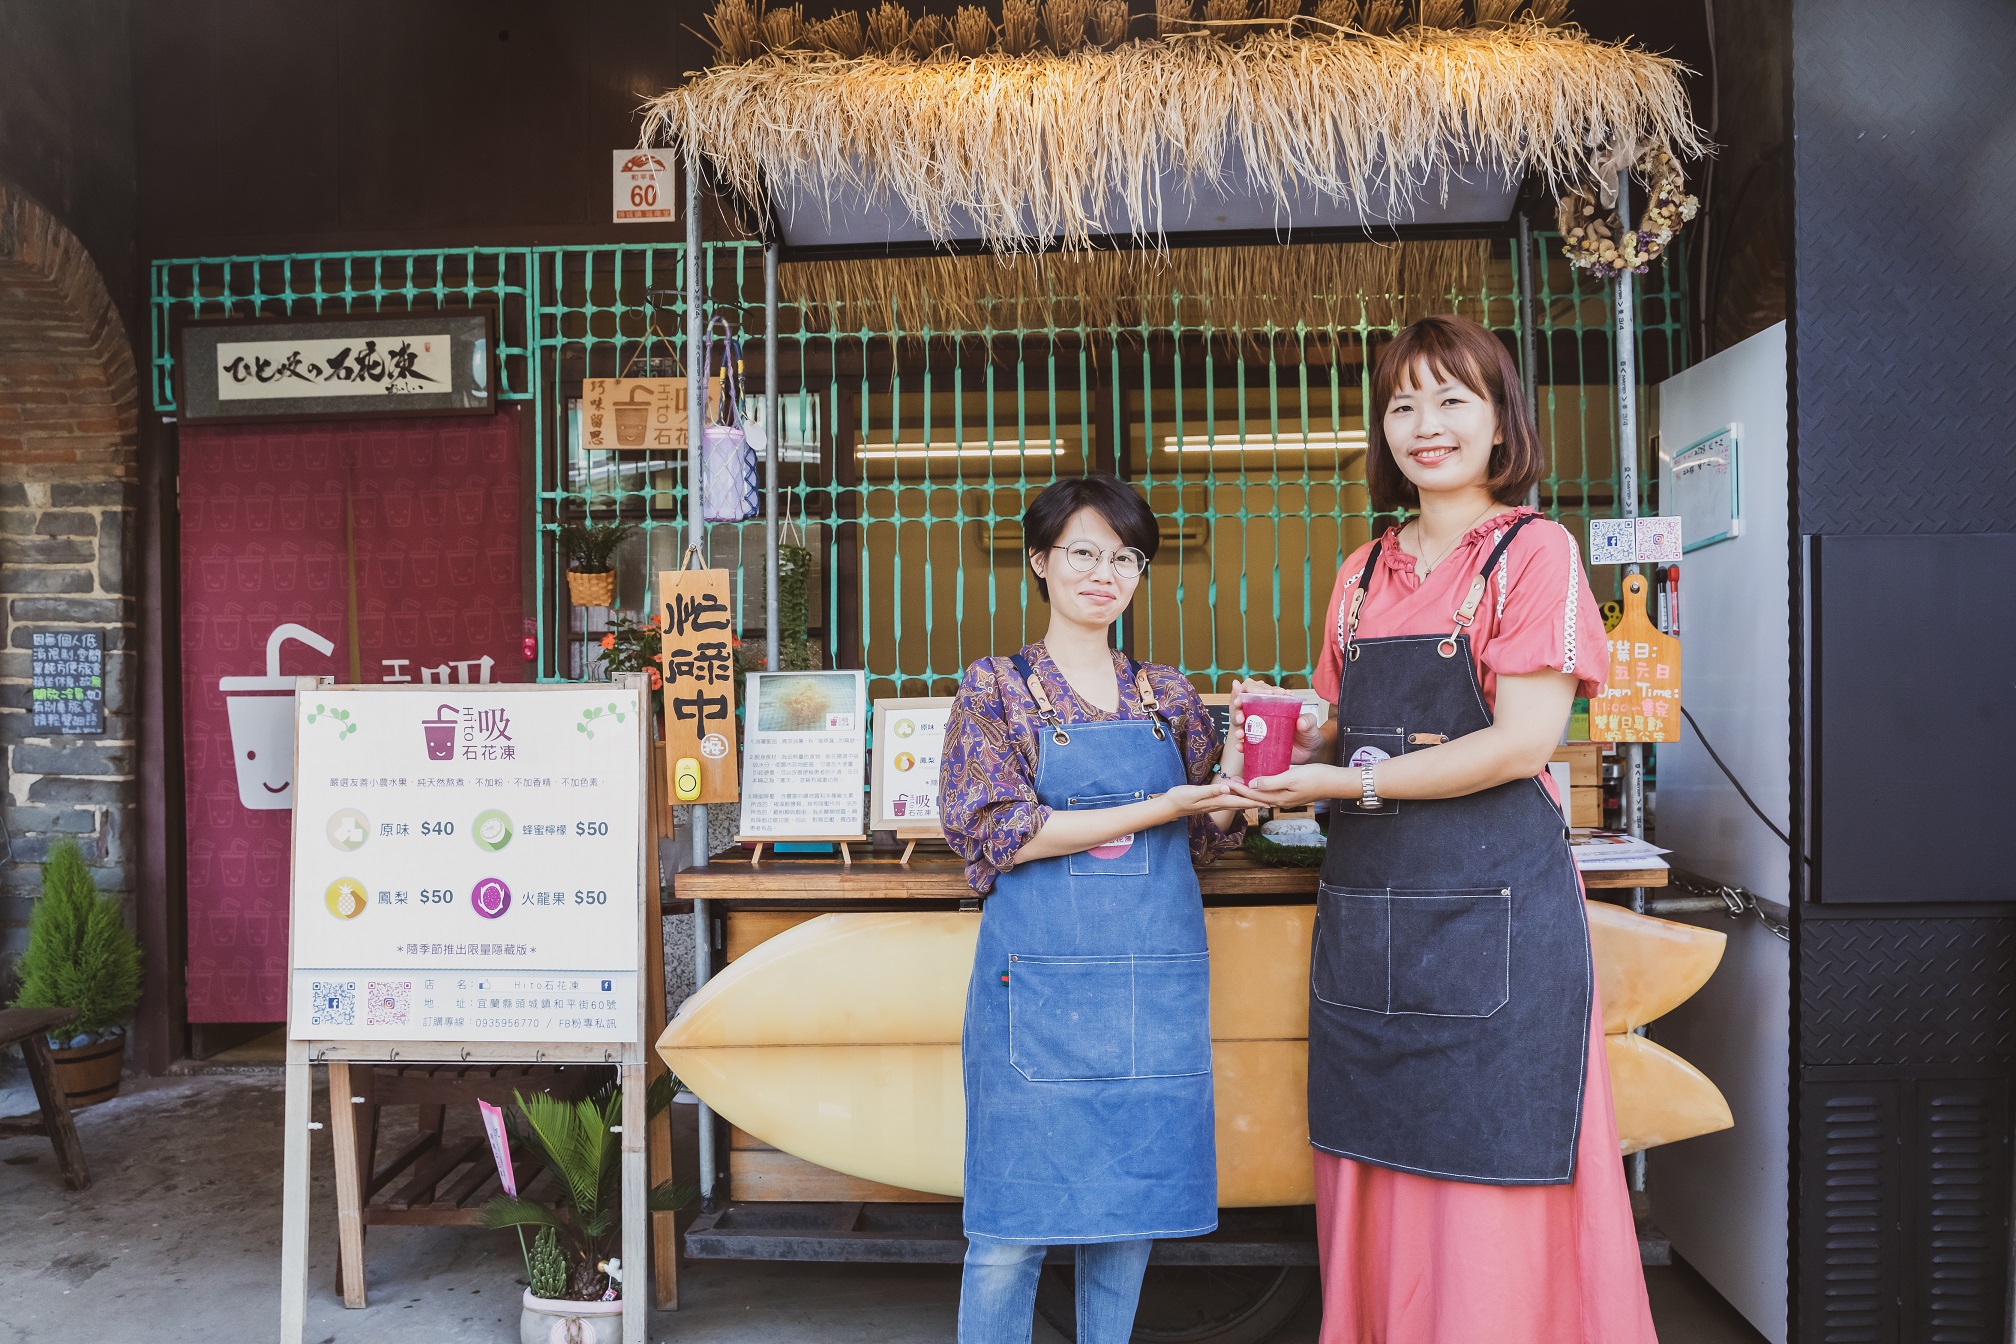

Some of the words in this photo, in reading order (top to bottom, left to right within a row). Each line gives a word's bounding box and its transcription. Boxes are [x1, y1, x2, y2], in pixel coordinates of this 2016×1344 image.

[631, 184, 657, 207] 60
[589, 380, 606, 446] 巧味留思
[657, 384, 673, 424] Hito
[663, 593, 731, 740] 忙碌中
[1635, 682, 1680, 699] Time:
[462, 707, 477, 741] Hito
[478, 707, 513, 742] 吸
[462, 745, 516, 761] 石花凍
[379, 822, 410, 836] 原味
[420, 820, 455, 837] $40
[522, 824, 567, 836] 蜂蜜檸檬
[575, 820, 609, 837] $50
[378, 890, 409, 905] 鳳梨
[419, 888, 454, 906] $50
[521, 891, 566, 907] 火龍果
[574, 889, 608, 906] $50
[424, 979, 435, 990] 店
